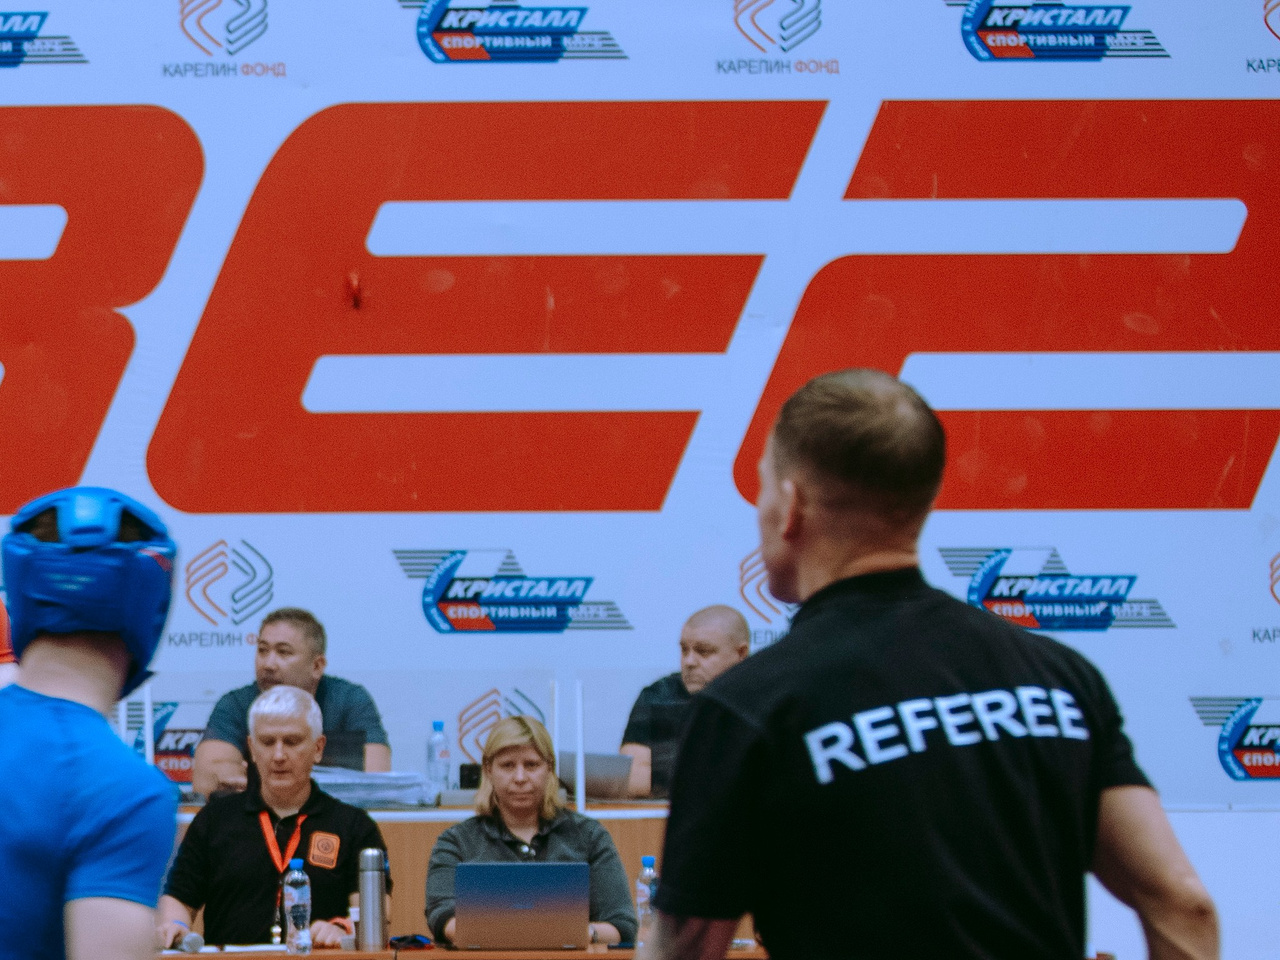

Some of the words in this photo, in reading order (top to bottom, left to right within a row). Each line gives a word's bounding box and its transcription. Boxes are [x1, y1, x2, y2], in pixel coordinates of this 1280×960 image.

[445, 10, 580, 29] КРИСТАЛЛ
[989, 8, 1124, 27] КРИСТАЛЛ
[444, 36, 551, 50] СПОРТИВНЫЙ
[988, 34, 1095, 48] СПОРТИВНЫЙ
[163, 62, 237, 78] КАРЕЛИН
[240, 62, 285, 77] ФОНД
[717, 58, 791, 74] КАРЕЛИН
[794, 58, 839, 73] ФОНД
[451, 580, 586, 599] КРИСТАЛЛ
[995, 578, 1130, 597] КРИСТАЛЛ
[450, 606, 557, 620] СПОРТИВНЫЙ
[994, 604, 1101, 618] СПОРТИВНЫЙ
[168, 632, 243, 647] КАРЕЛИН
[804, 685, 1090, 785] REFEREE
